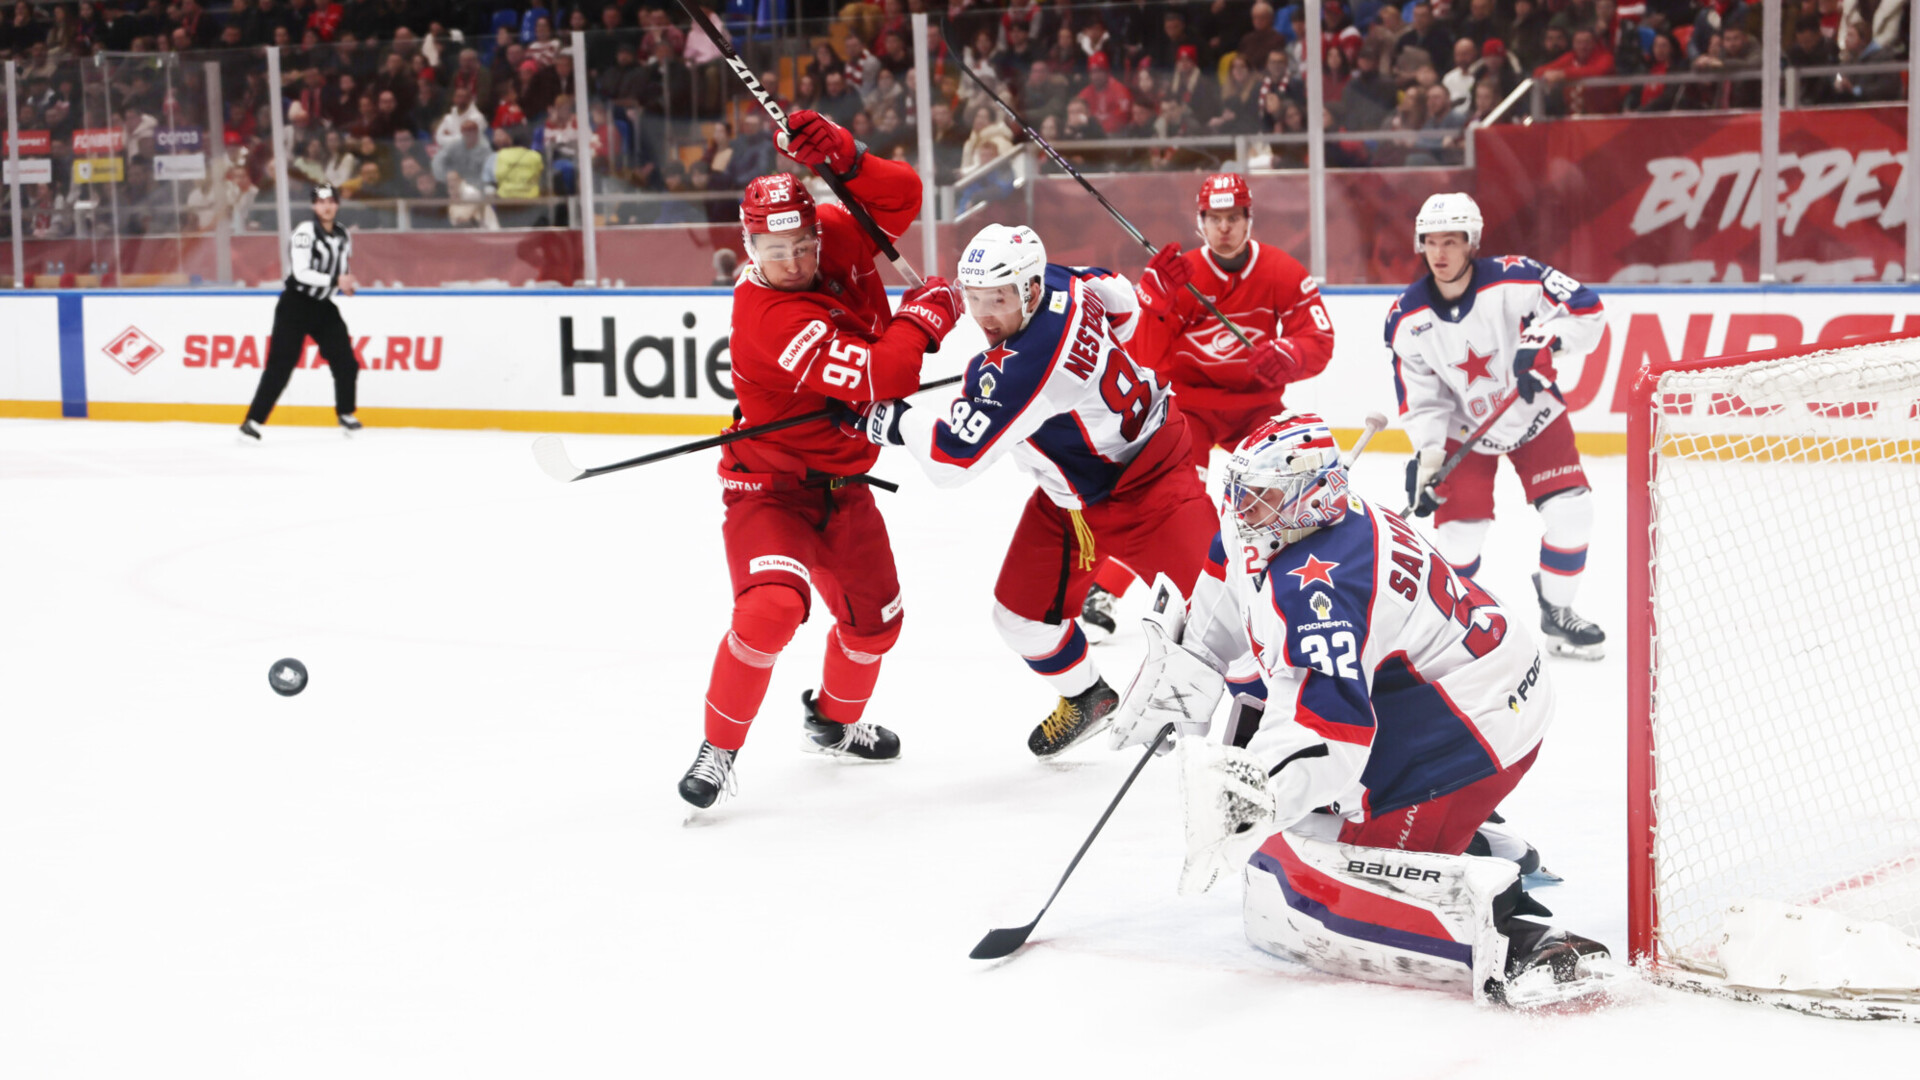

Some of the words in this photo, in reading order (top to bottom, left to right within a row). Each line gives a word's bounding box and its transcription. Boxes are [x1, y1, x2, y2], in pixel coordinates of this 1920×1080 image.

[769, 188, 790, 203] 95
[967, 249, 986, 263] 89
[899, 303, 943, 329] СПАРТ
[560, 311, 738, 401] Haie
[782, 322, 822, 368] OLIMPBET
[822, 339, 868, 390] 95
[950, 401, 991, 445] 89
[758, 558, 809, 578] OLIMPBET
[1296, 619, 1353, 633] РОСНЕФТЬ
[1299, 630, 1359, 680] 32
